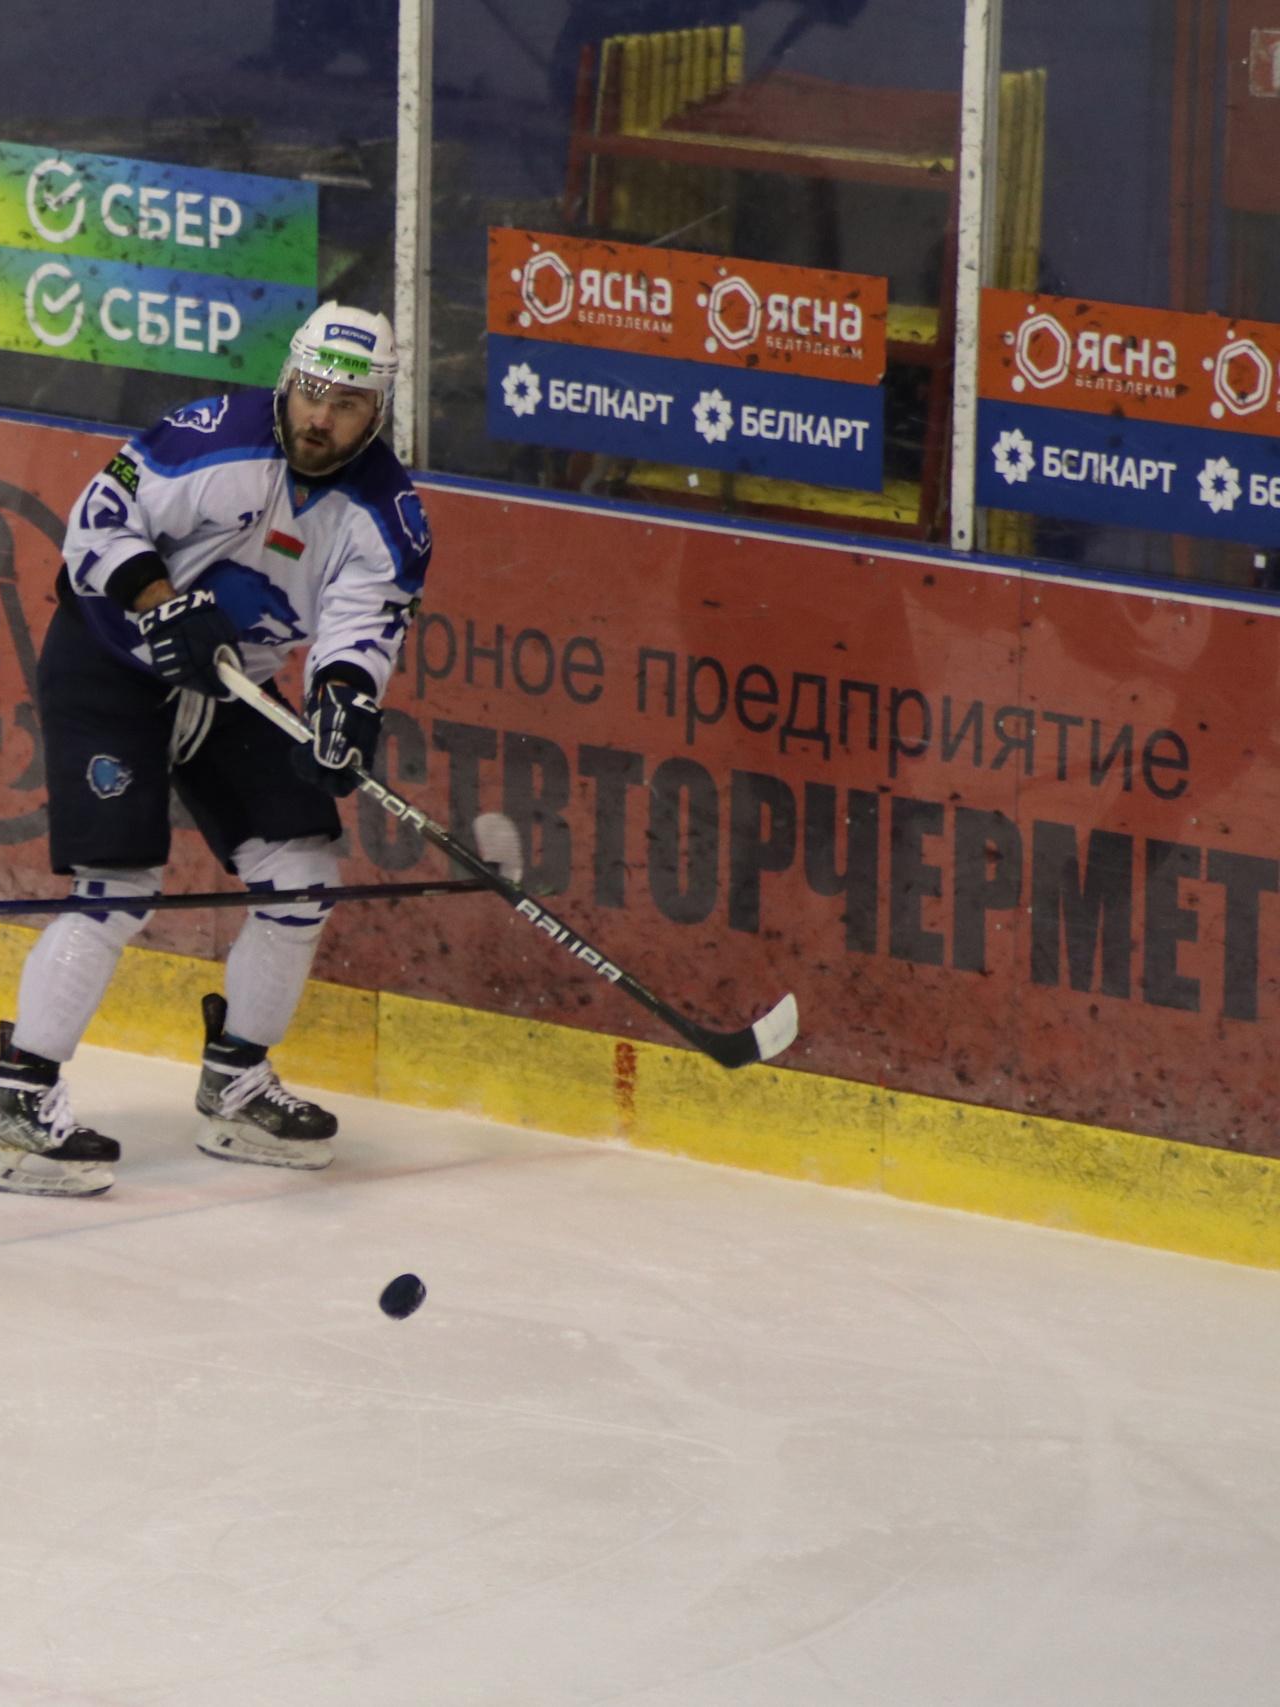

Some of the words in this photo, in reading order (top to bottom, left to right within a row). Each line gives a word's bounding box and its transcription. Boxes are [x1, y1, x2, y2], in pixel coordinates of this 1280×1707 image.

[101, 184, 242, 249] СБЕР
[100, 287, 241, 354] СБЕР
[549, 379, 674, 425] БЕЛКАРТ
[741, 406, 869, 451] БЕЛКАРТ
[1043, 446, 1177, 494] БЕЛКАРТ
[139, 590, 215, 635] CCM
[636, 646, 1190, 800] предприятие
[328, 707, 1280, 1023] СТВТОРЧЕРМЕТ
